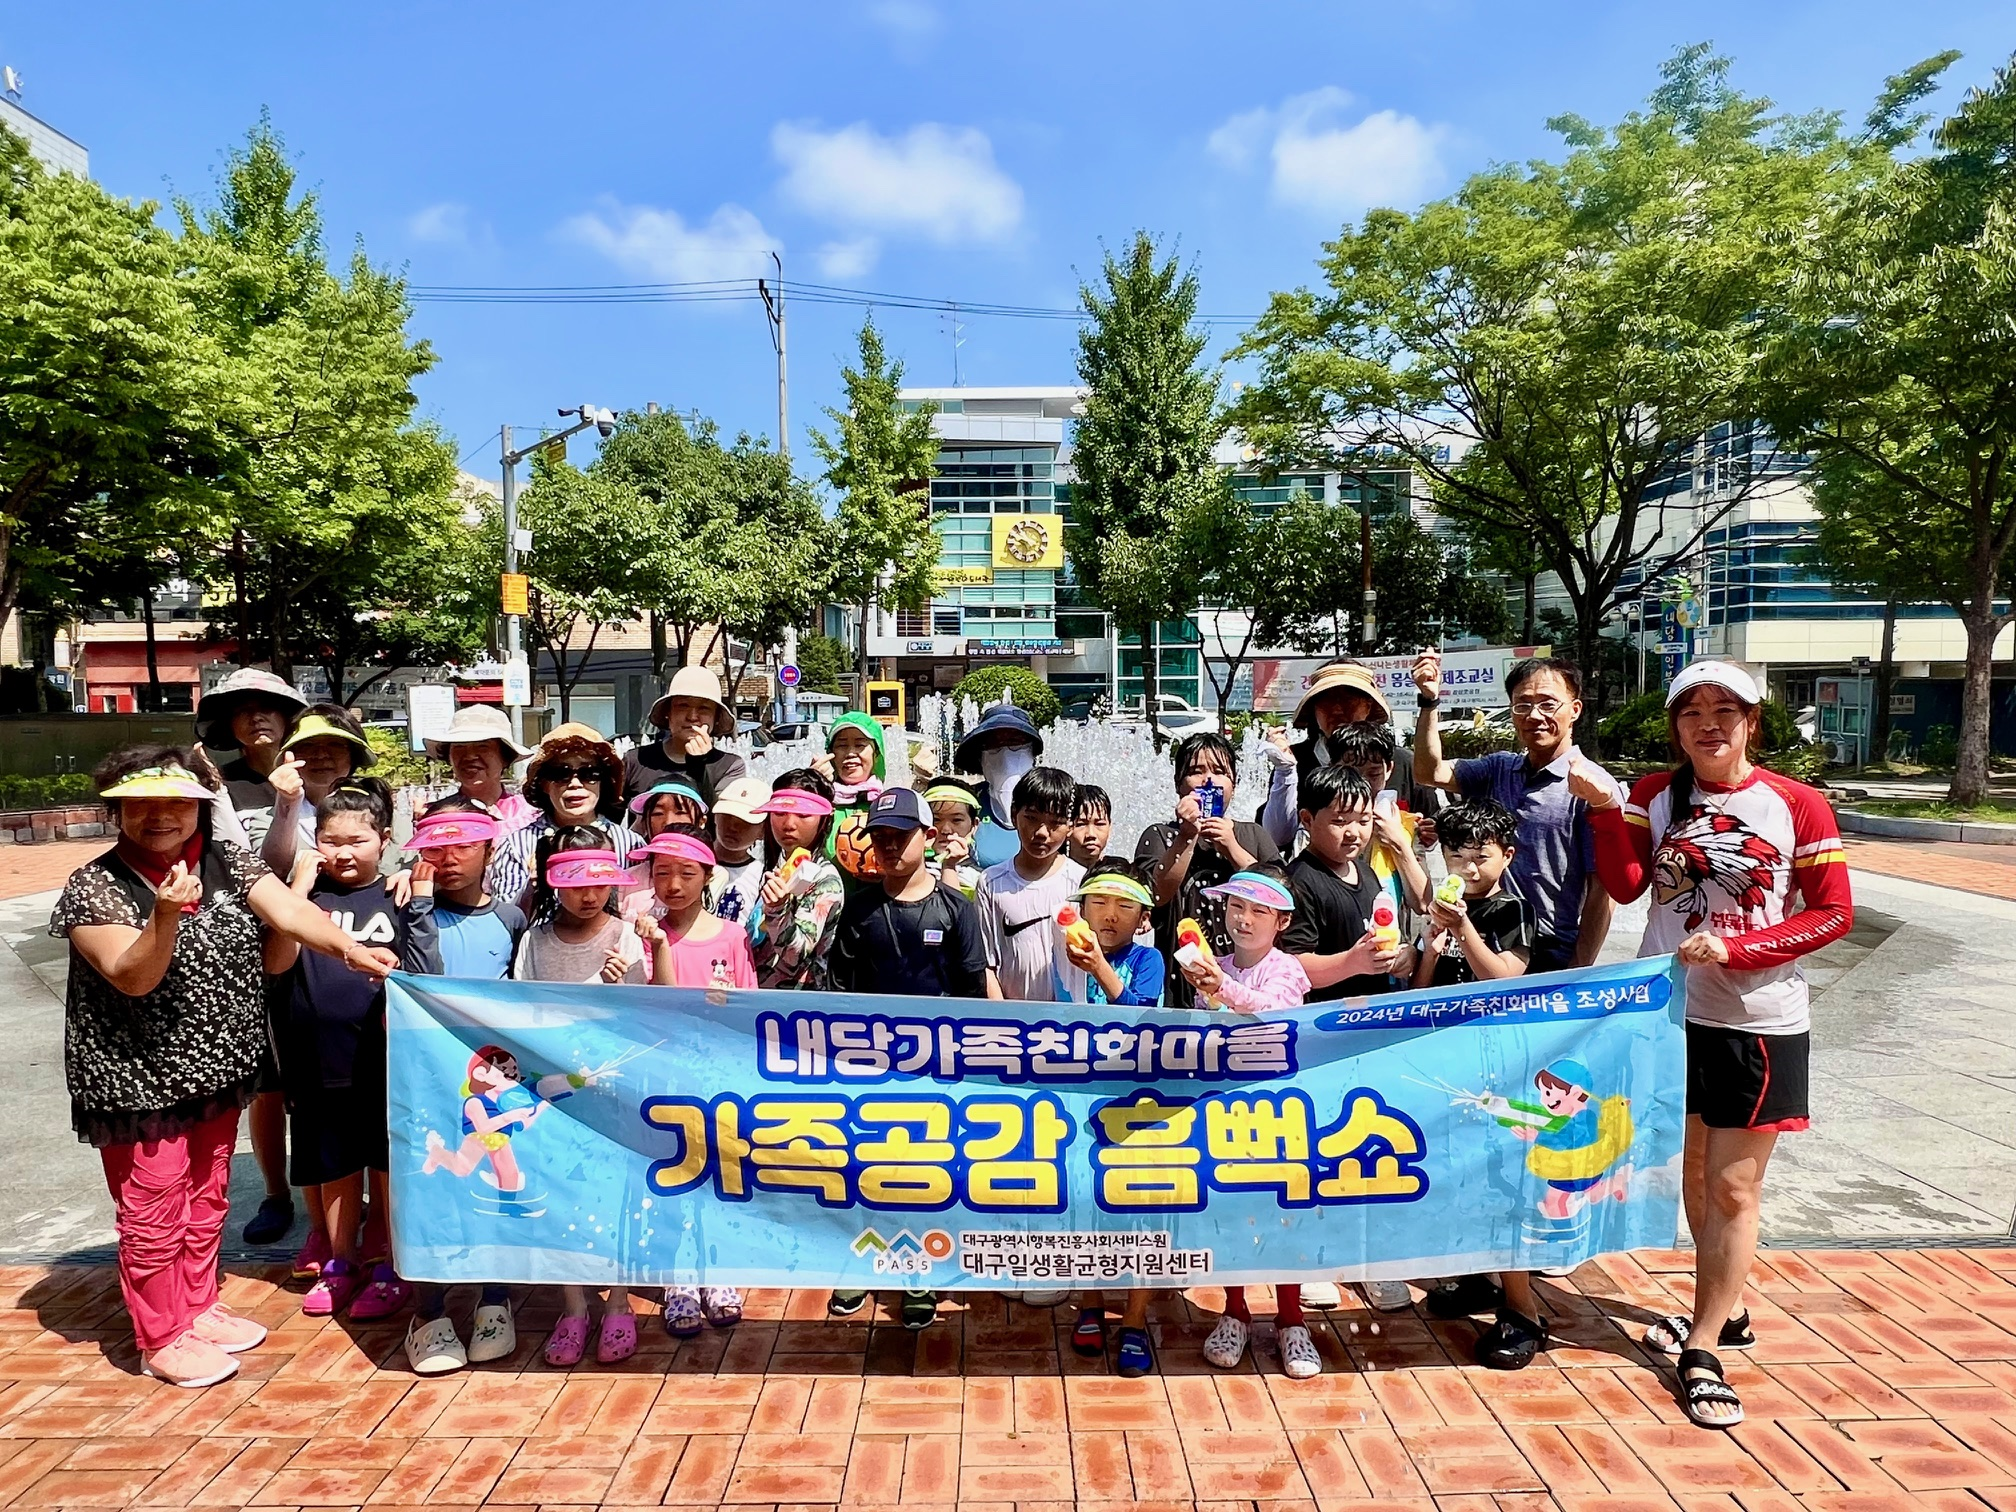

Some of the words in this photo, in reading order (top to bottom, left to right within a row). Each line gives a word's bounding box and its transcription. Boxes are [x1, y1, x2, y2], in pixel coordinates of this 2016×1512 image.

[1441, 667, 1494, 685] 체조교실
[330, 910, 395, 943] ILA
[1335, 1005, 1405, 1025] 2024년
[1409, 992, 1570, 1018] 대구가족친화마을
[1576, 984, 1650, 1009] 조성사업
[763, 1017, 1290, 1077] 내당가족친화마을
[648, 1099, 1067, 1207] 가족공감
[1097, 1095, 1421, 1207] 흠뻑쇼
[962, 1233, 1168, 1249] 대구광역시행복진흥사회서비스원
[876, 1258, 929, 1271] PASS
[962, 1251, 1210, 1278] 대구일생활균형지원센터
